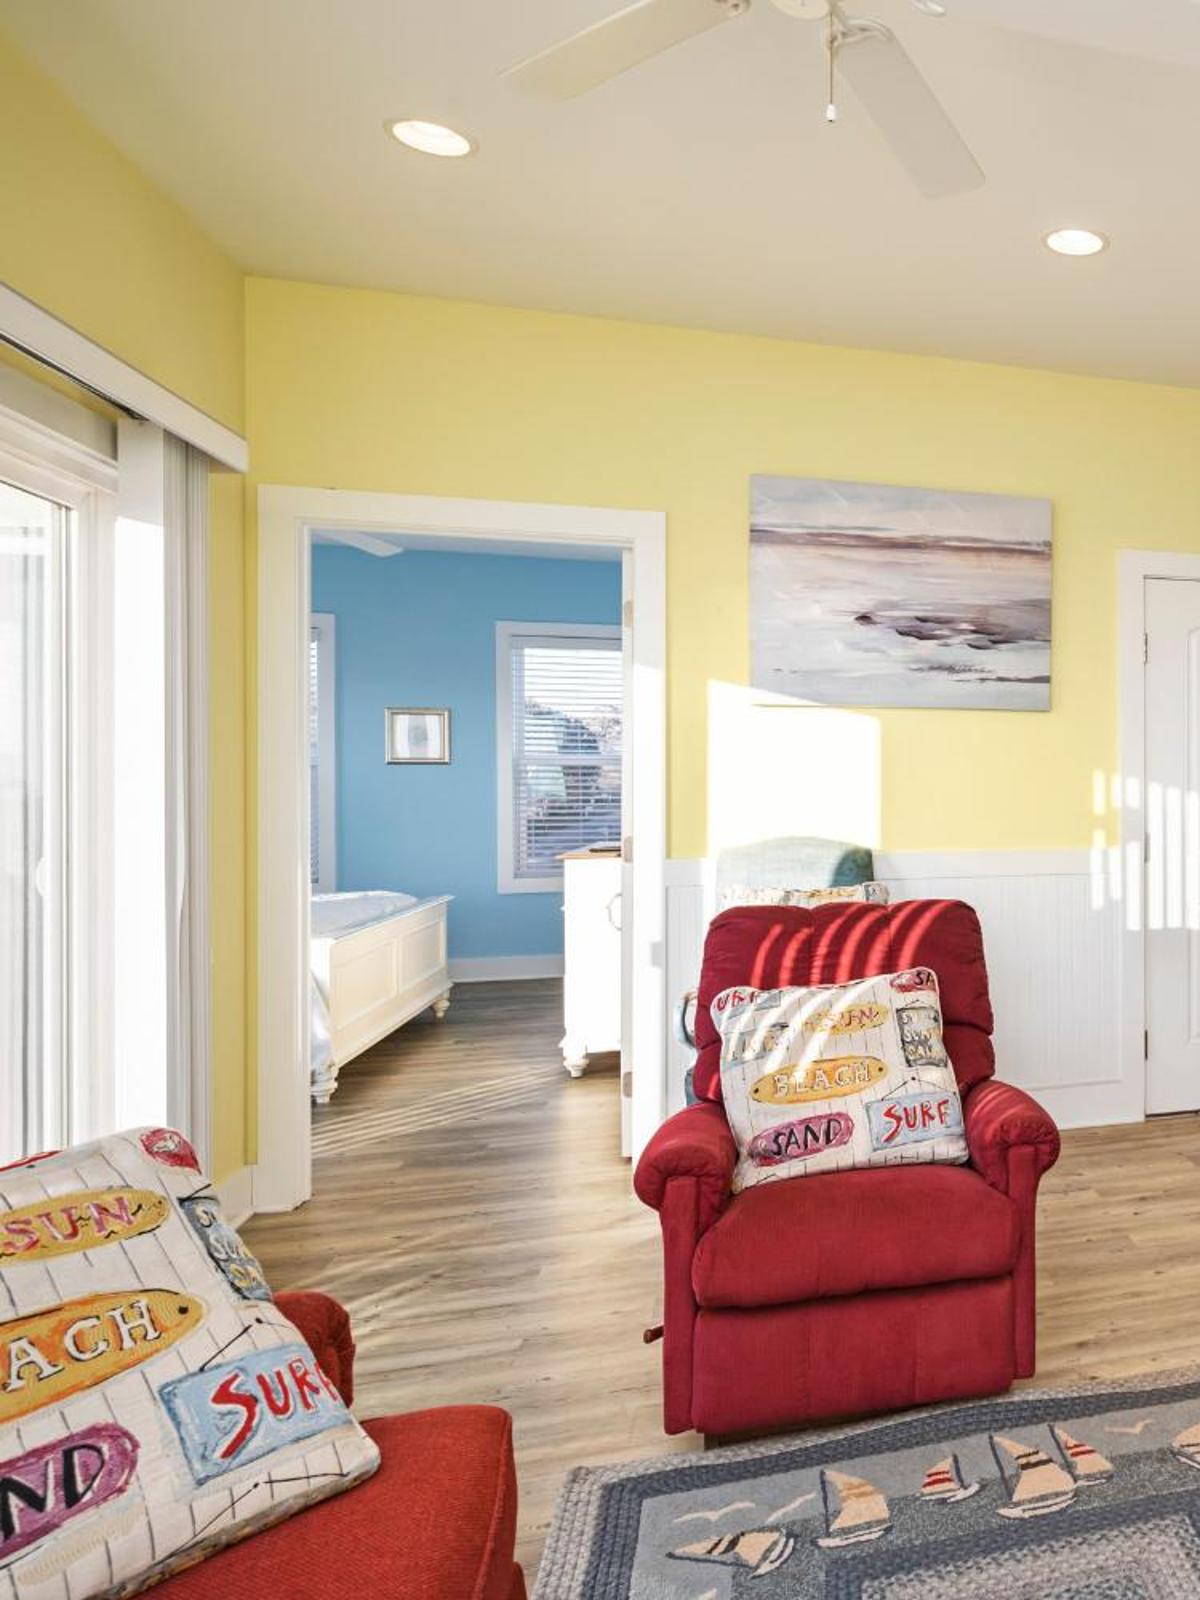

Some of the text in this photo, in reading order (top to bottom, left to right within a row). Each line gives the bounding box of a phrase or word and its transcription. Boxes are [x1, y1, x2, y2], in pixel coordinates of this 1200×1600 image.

[773, 1061, 870, 1097] BEACH
[772, 1118, 842, 1156] SAND
[882, 1099, 950, 1143] SURF
[2, 1196, 135, 1252] SUN
